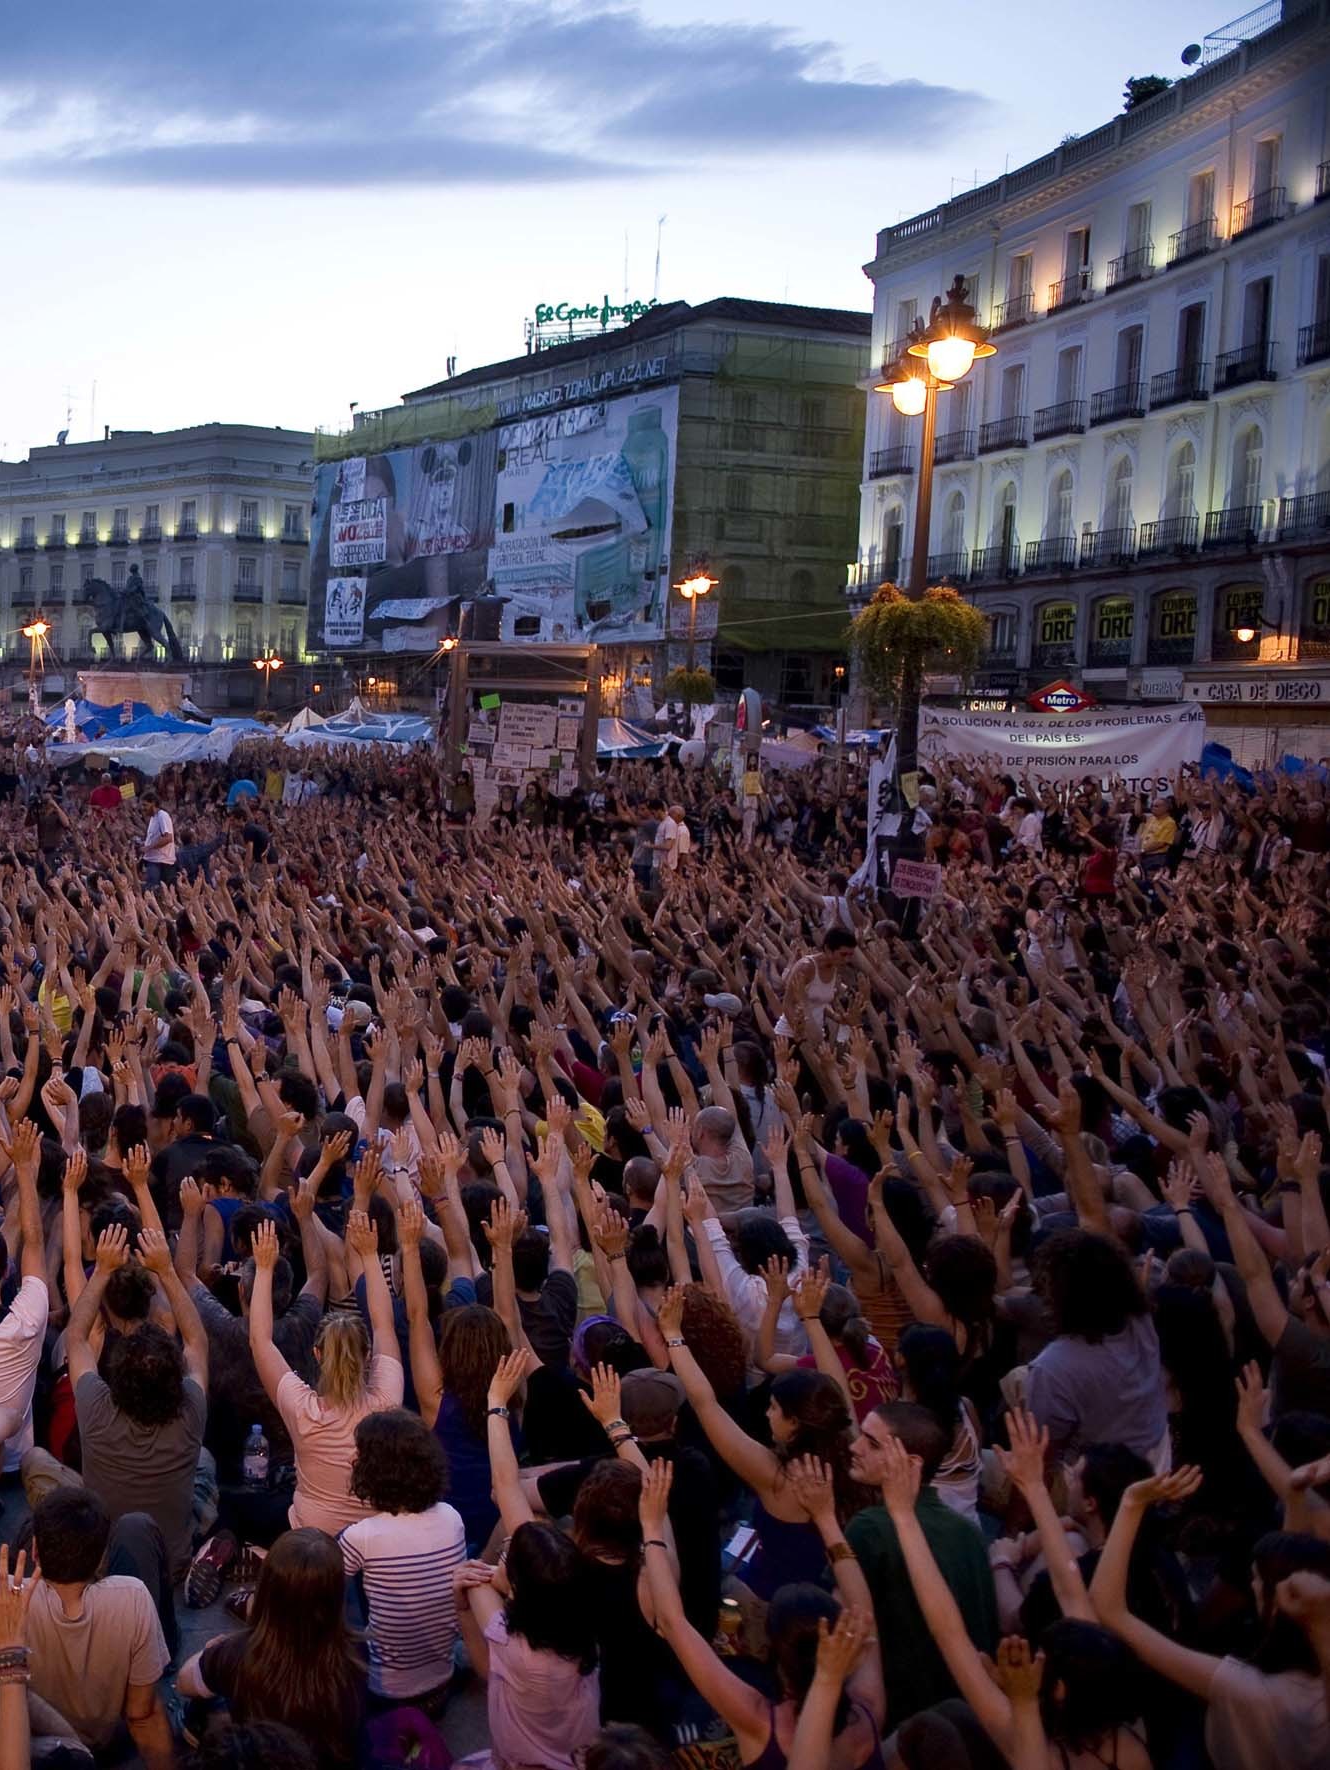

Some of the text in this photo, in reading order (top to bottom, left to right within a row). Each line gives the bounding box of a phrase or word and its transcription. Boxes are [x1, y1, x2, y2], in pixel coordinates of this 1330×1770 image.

[535, 303, 553, 323] El
[555, 302, 599, 322] Corte
[1208, 682, 1321, 700] CASA DE DIEGO
[1047, 695, 1077, 705] Metro
[924, 714, 939, 725] LA
[941, 715, 1001, 728] SOLUCIÓN
[1003, 720, 1019, 728] AL
[1048, 720, 1066, 729] DE
[1068, 719, 1092, 728] LOS
[1095, 713, 1172, 727] PROBLEMAS
[1009, 733, 1032, 743] DEL
[1034, 731, 1062, 743] PAÍS
[1006, 756, 1024, 767] DE
[1026, 752, 1076, 767] PRISIÓN
[1079, 755, 1112, 766] PARA
[1114, 753, 1139, 765] LOS
